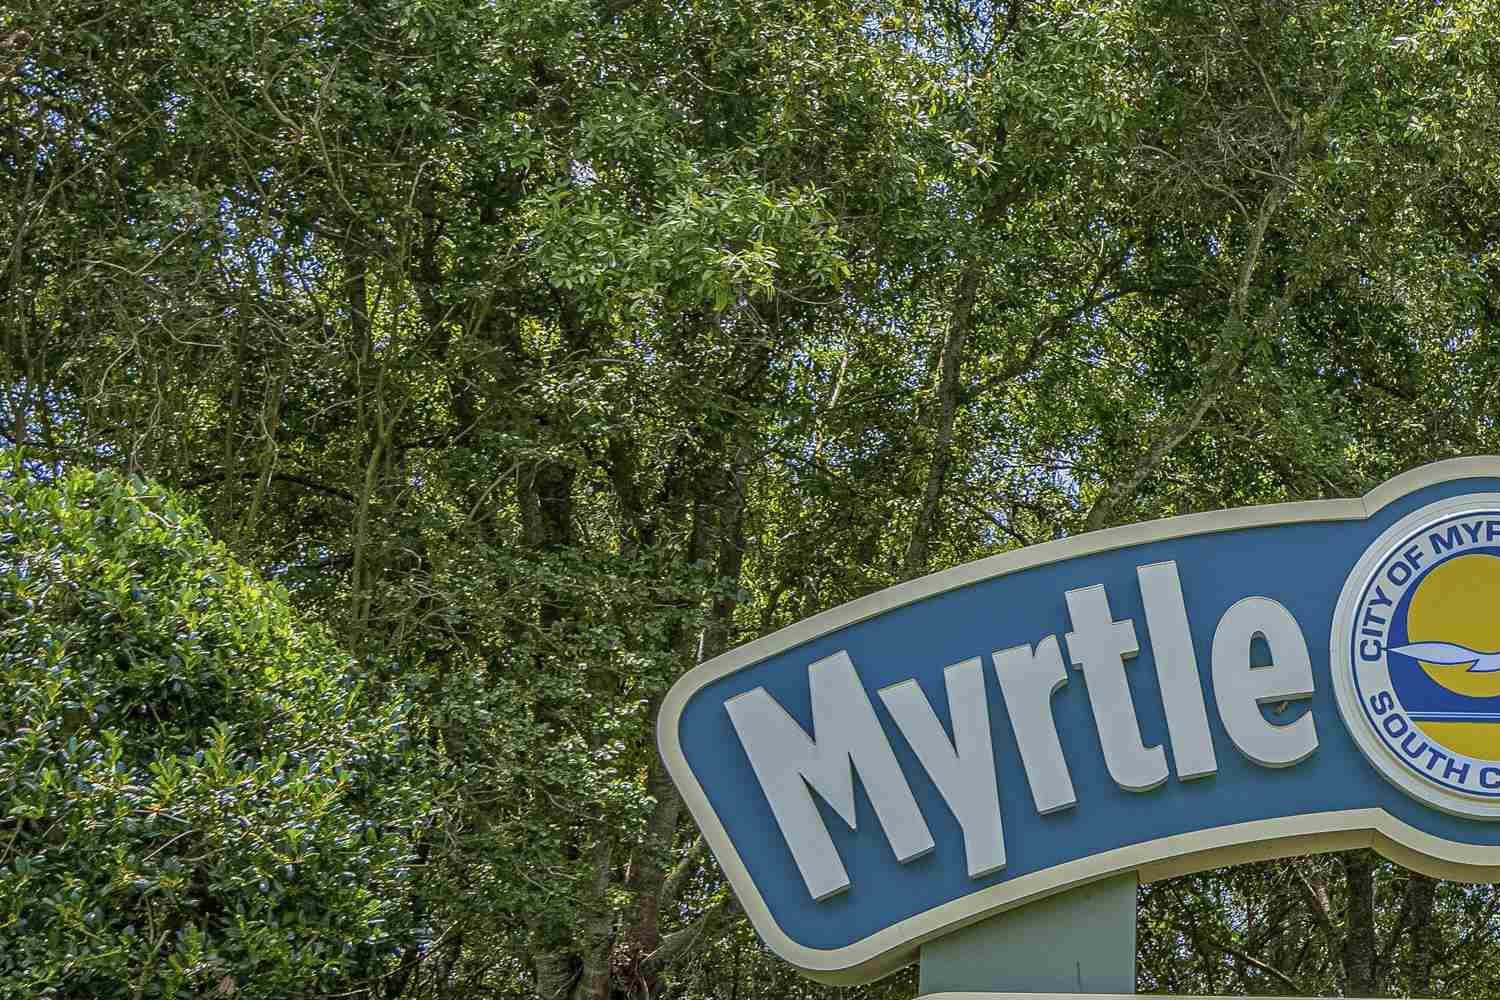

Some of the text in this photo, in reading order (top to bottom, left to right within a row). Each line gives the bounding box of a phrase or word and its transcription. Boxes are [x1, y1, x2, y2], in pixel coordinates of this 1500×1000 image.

[1358, 585, 1394, 662] CITY
[1386, 544, 1424, 586] OF
[723, 559, 1320, 902] Myrtle
[1369, 690, 1471, 784] SOUTH
